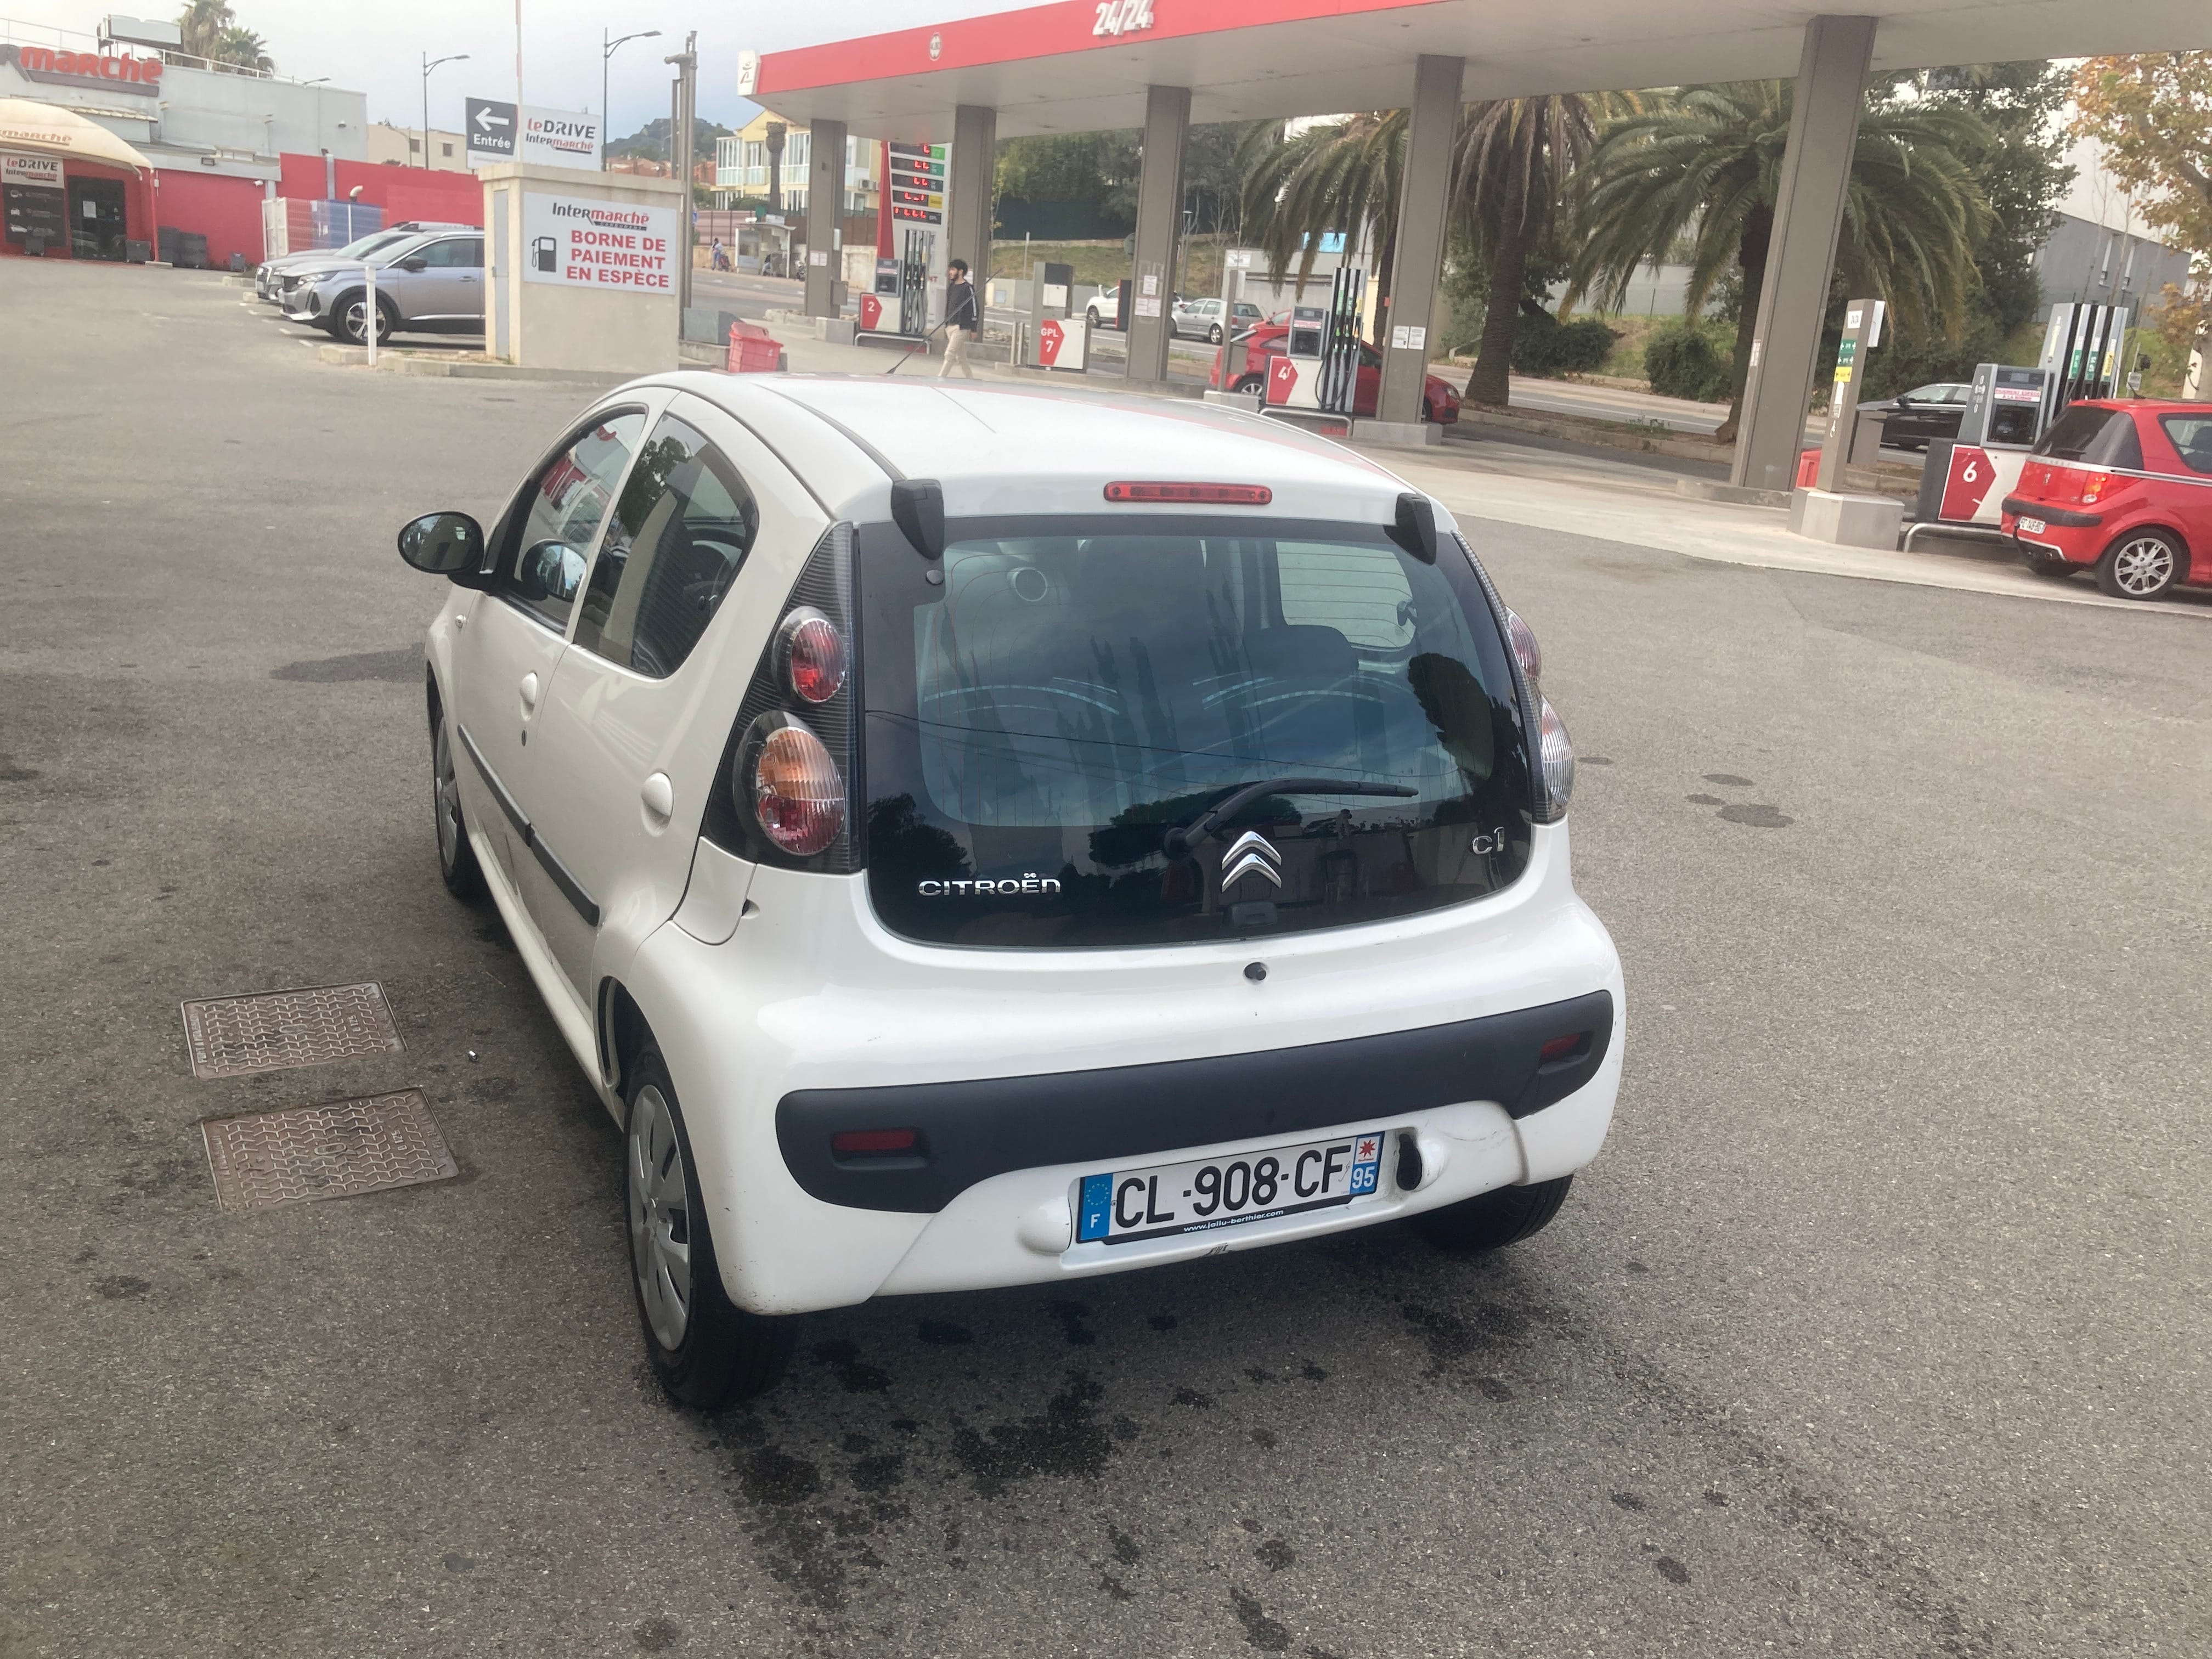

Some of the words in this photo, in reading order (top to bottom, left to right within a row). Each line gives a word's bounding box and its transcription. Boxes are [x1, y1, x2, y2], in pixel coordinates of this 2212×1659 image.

[1092, 0, 1154, 35] 24/24
[473, 133, 511, 149] Entrée
[552, 202, 649, 226] Intermarché
[571, 230, 636, 249] BORNE
[642, 237, 666, 252] DE
[571, 248, 665, 270] PAIEMENT
[567, 266, 591, 281] EN
[599, 268, 669, 288] ESPÈCE
[868, 302, 875, 312] 2
[1041, 328, 1059, 337] GPL
[1046, 340, 1054, 352] 7
[1963, 462, 1978, 482] 6
[1352, 1166, 1375, 1189] 95
[1090, 1214, 1101, 1228] F
[1183, 1209, 1284, 1232] www.jallu-berthier.com
